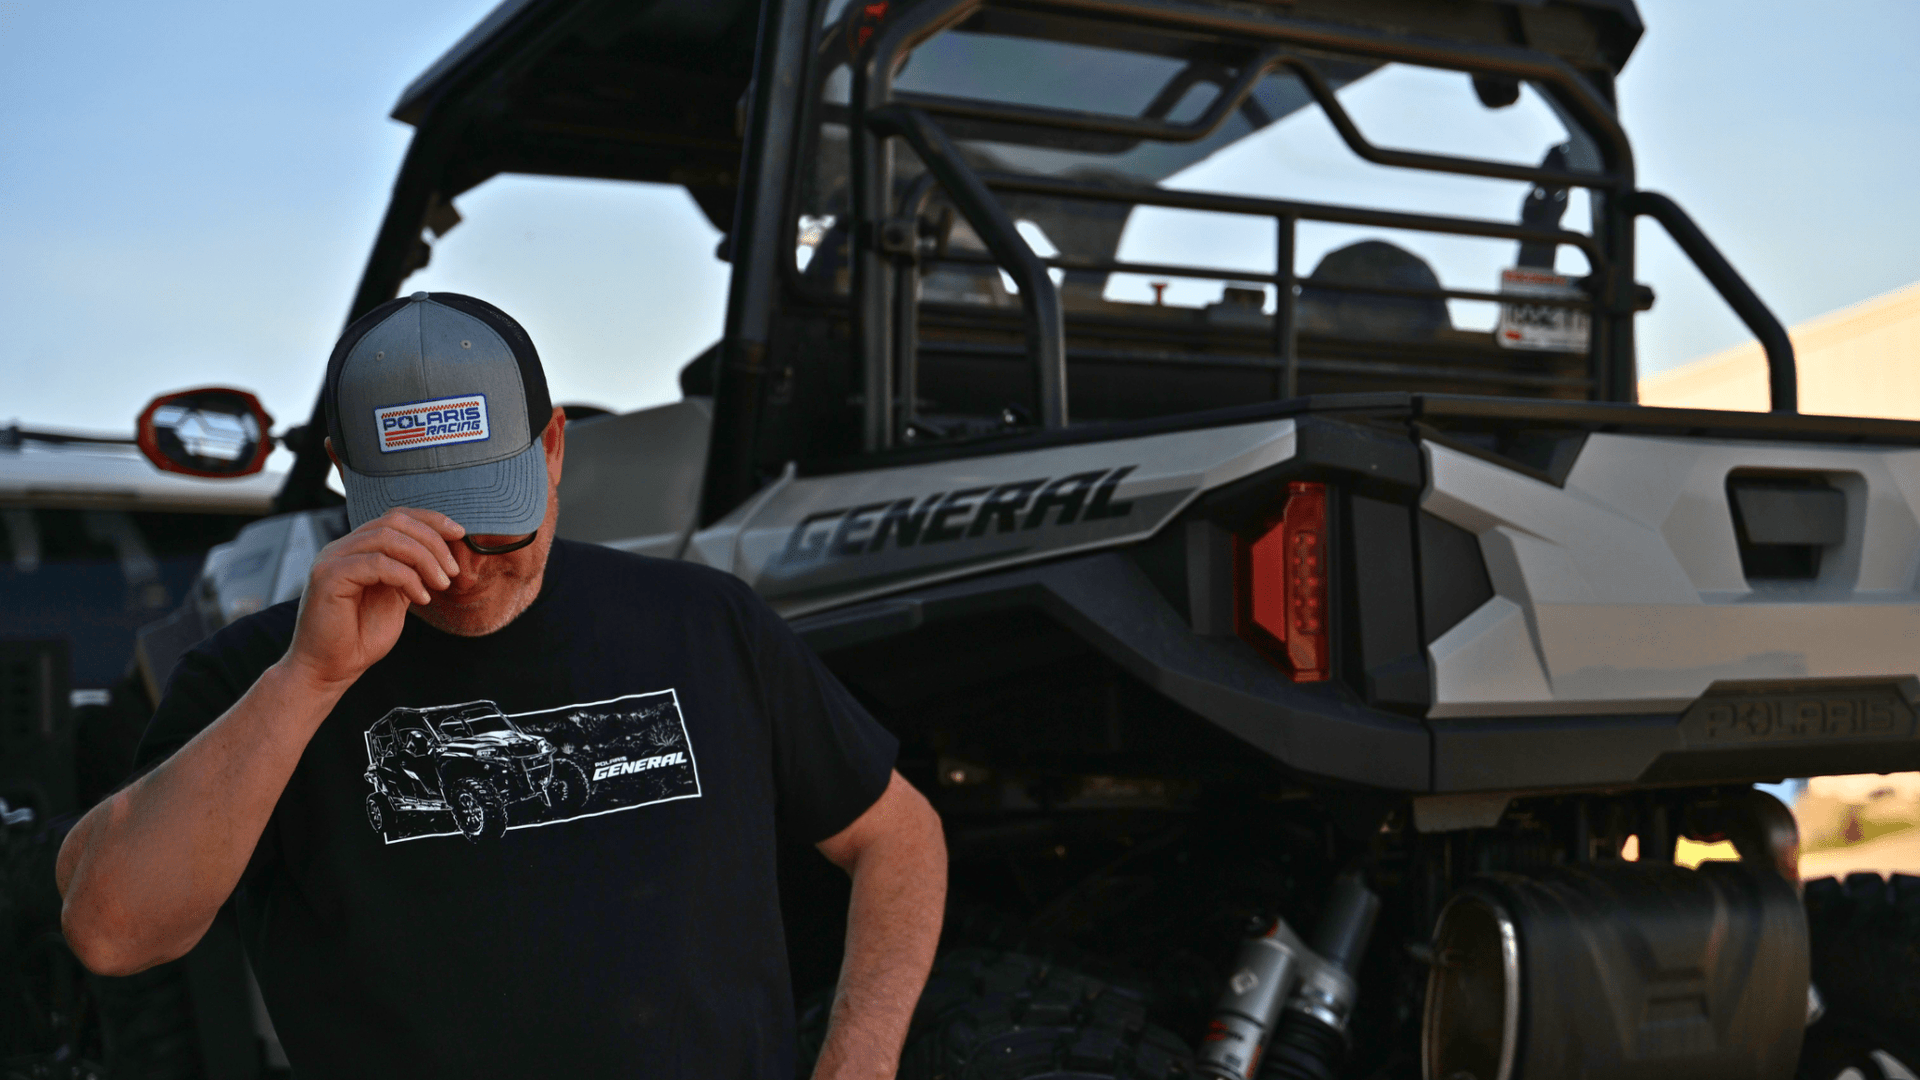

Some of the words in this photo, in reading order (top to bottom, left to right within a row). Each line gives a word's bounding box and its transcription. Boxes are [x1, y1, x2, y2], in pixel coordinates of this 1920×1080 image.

[383, 407, 480, 431] POLARIS
[426, 420, 481, 435] RACING
[780, 465, 1138, 567] GENERAL
[1706, 700, 1896, 738] POLARIS
[593, 752, 687, 781] GENERAL
[595, 756, 627, 767] POLARIS
